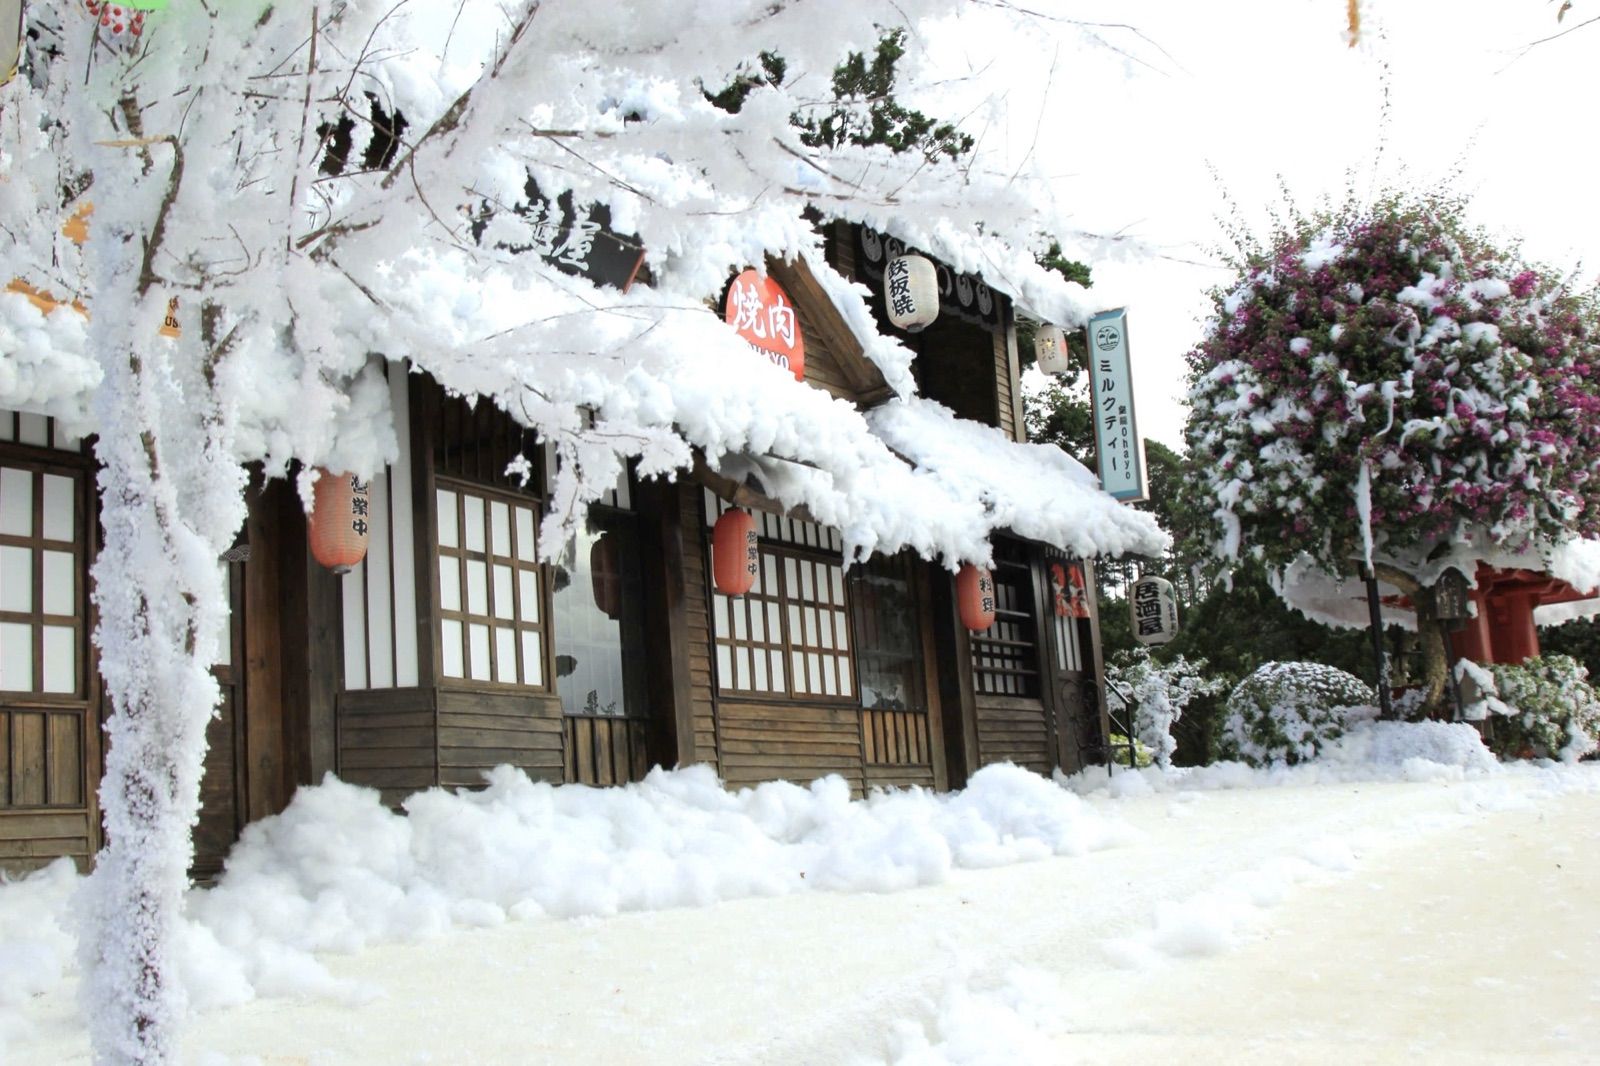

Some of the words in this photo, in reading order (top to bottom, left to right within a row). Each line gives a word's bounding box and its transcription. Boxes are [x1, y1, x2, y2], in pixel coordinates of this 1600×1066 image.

[1100, 359, 1117, 471] ミルクティー
[1135, 582, 1163, 636] 居酒屋
